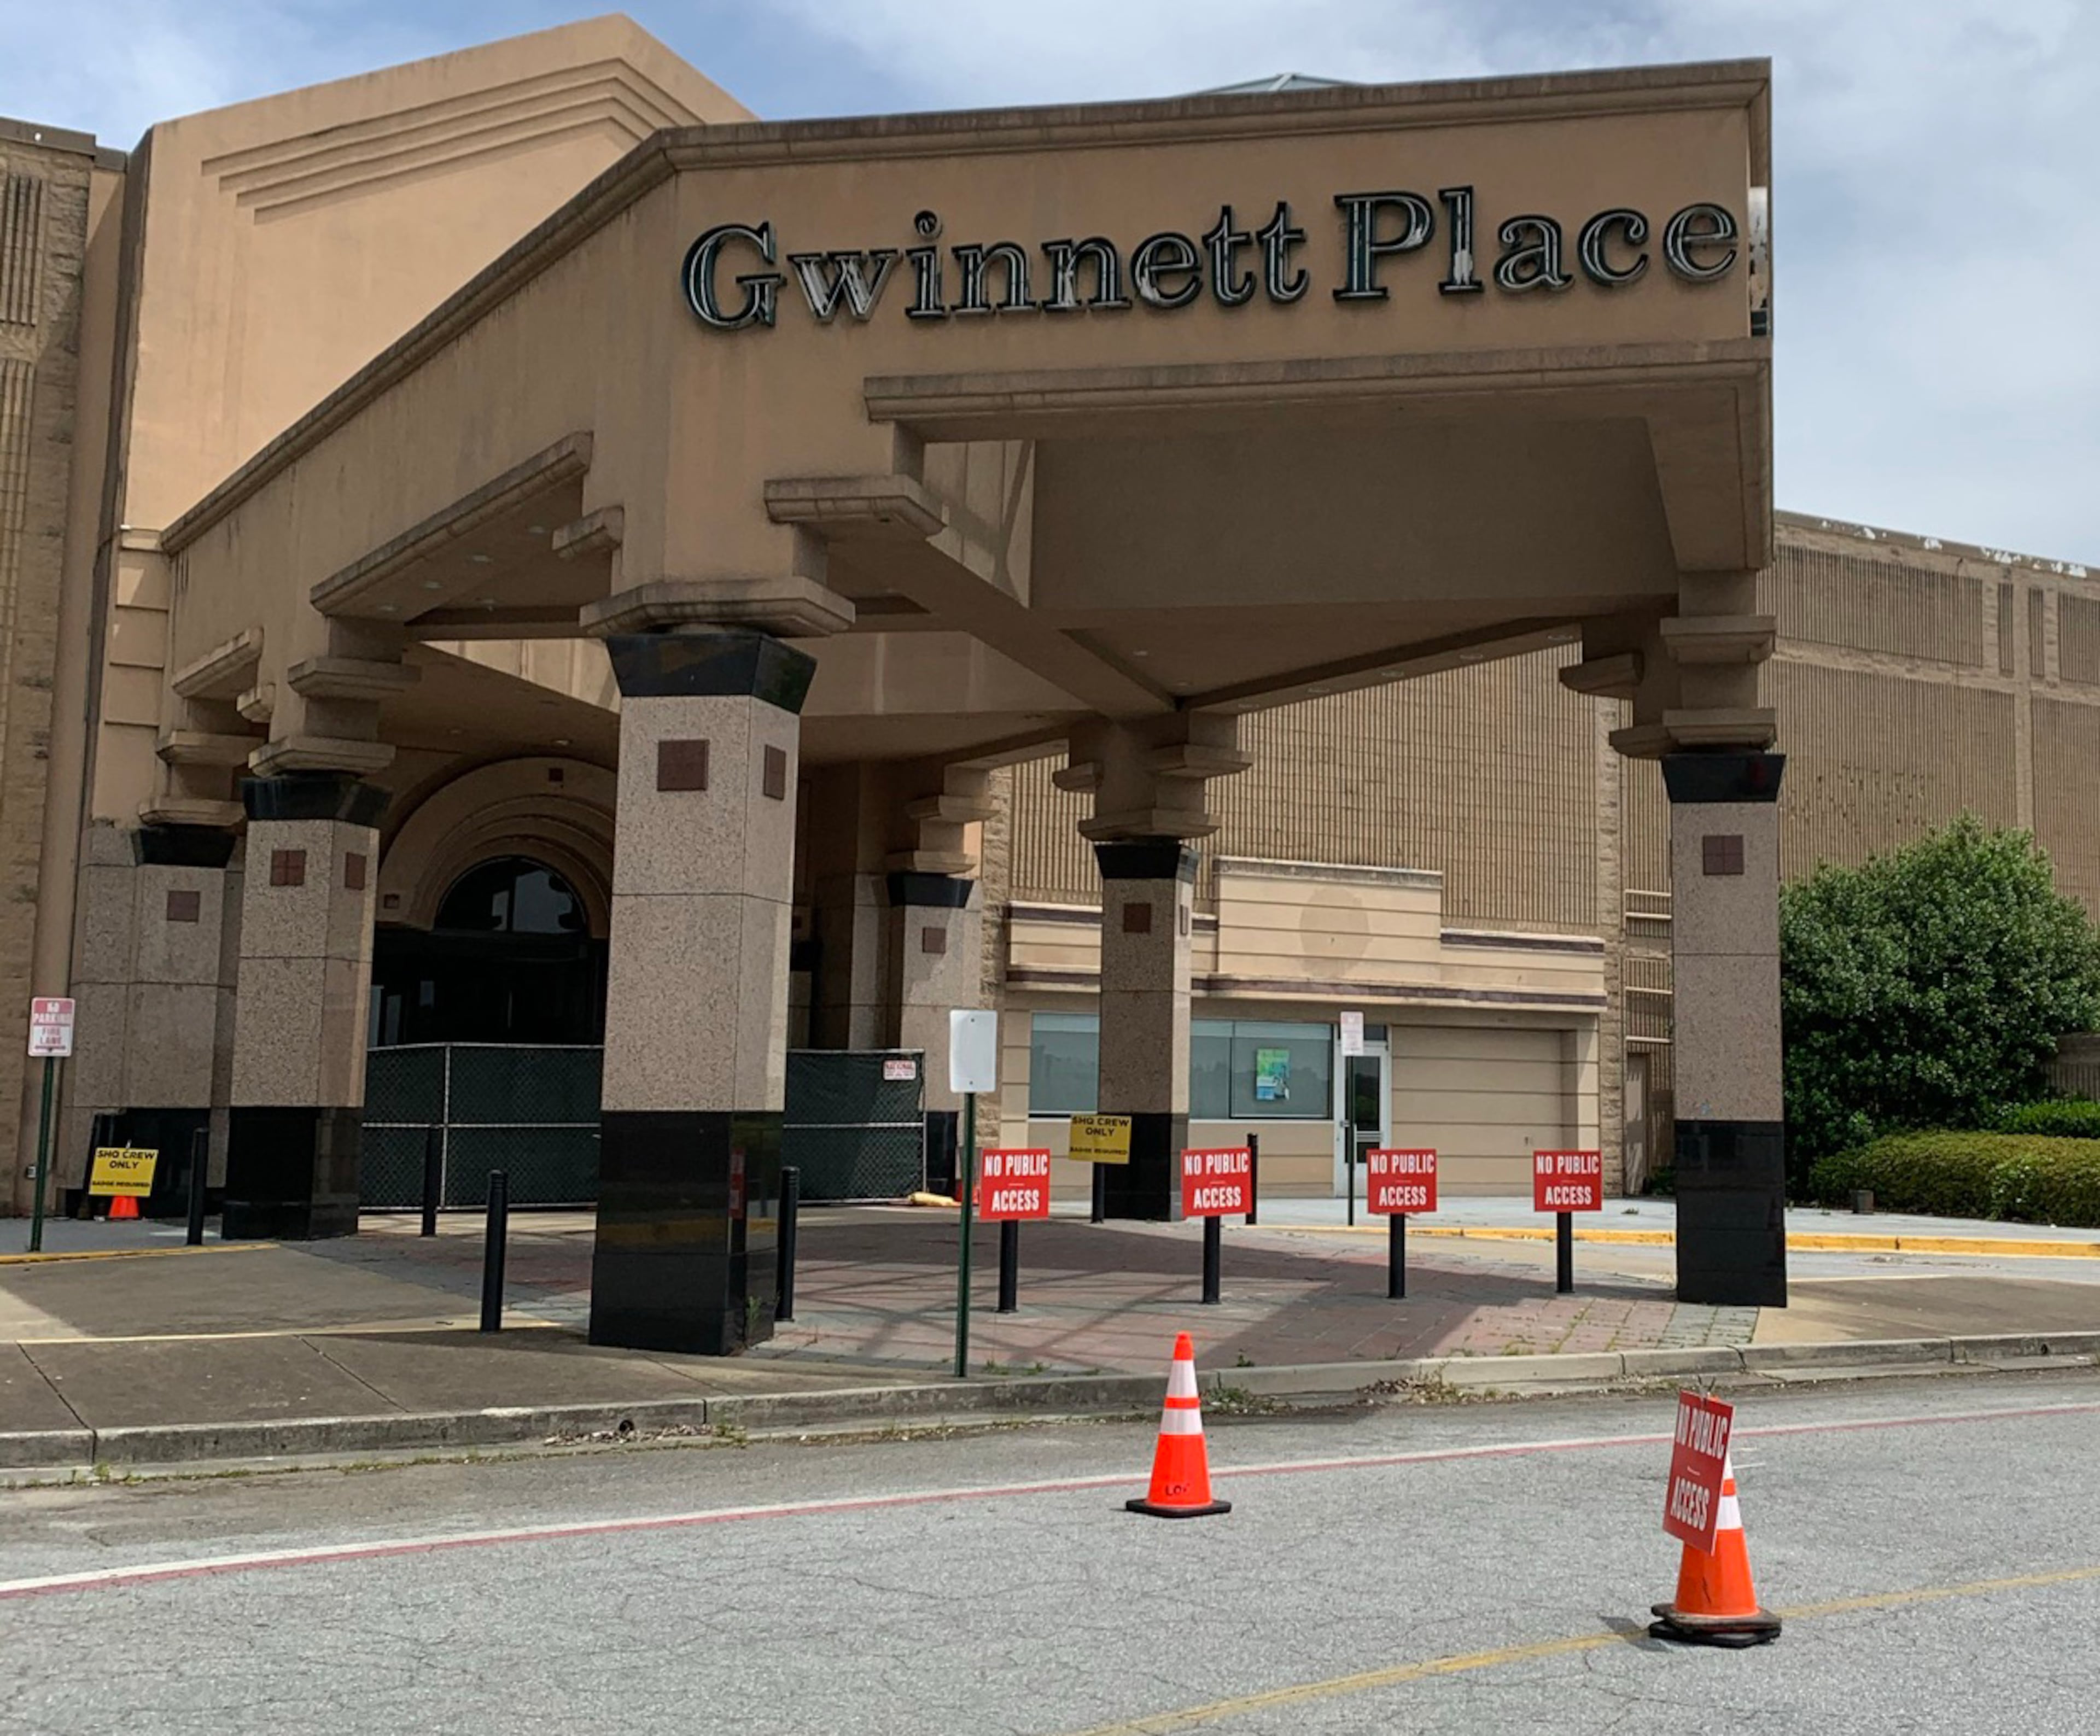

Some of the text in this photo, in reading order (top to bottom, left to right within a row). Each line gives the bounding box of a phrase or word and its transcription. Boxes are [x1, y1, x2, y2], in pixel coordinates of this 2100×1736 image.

[681, 185, 1740, 328] Gwinnett Place
[47, 1001, 60, 1013] NO
[1086, 1127, 1114, 1136] ONLY
[1098, 1118, 1129, 1127] CREW
[110, 1160, 139, 1169] ONLY
[123, 1151, 155, 1159] CREW
[1184, 1152, 1249, 1176] NO PUBLIC
[1370, 1154, 1434, 1174] NO PUBLIC
[1536, 1155, 1600, 1174] NO PUBLIC
[984, 1154, 1048, 1177] NO PUBLIC
[991, 1189, 1040, 1212] ACCESS
[1193, 1186, 1241, 1209] ACCESS
[1379, 1185, 1427, 1206] ACCESS
[1544, 1185, 1592, 1205] ACCESS
[1676, 1403, 1728, 1459] NO PUBLIC
[1670, 1476, 1710, 1532] ACCESS
